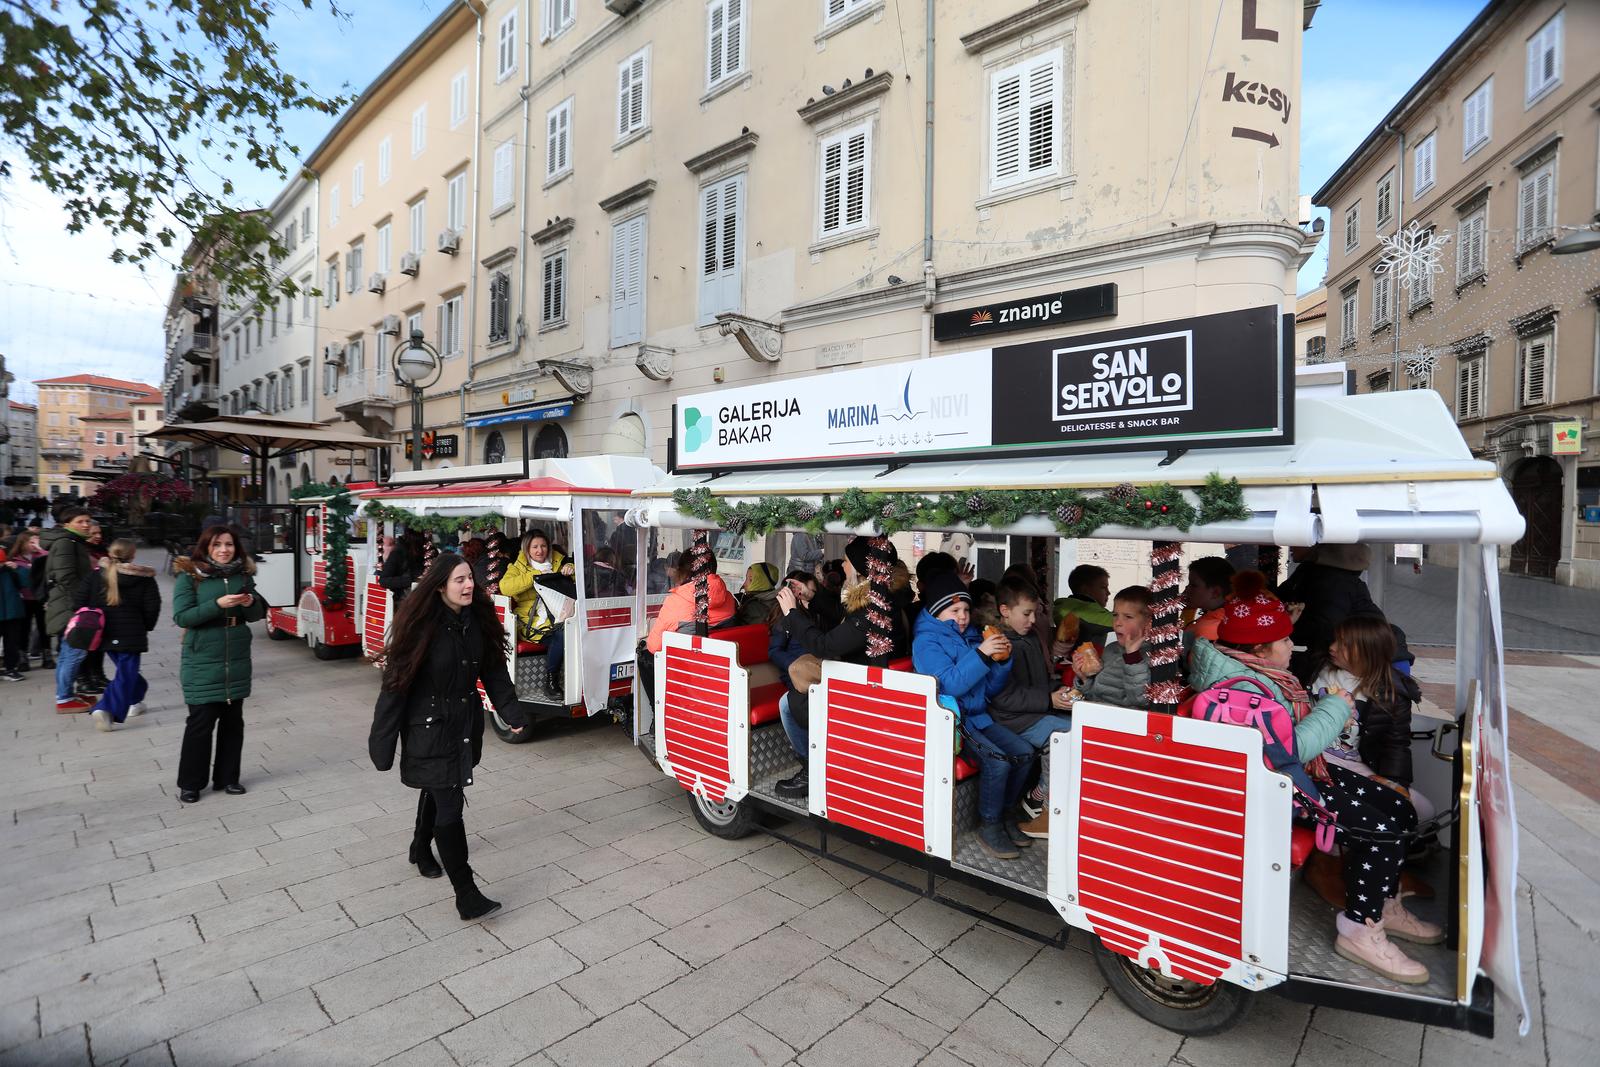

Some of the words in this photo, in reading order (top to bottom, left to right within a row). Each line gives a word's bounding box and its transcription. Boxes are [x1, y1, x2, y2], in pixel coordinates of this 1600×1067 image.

[1221, 71, 1292, 124] kosy
[998, 299, 1063, 324] znanje
[1092, 347, 1148, 380] SAN
[1061, 372, 1182, 411] SERVOLO
[718, 397, 801, 424] GALERIJA
[828, 403, 879, 430] MARINA
[929, 393, 969, 420] NOVI
[718, 424, 772, 447] BAKAR
[1060, 421, 1116, 433] DELICATESSE
[1118, 421, 1125, 429] &
[1127, 418, 1159, 428] SNACK
[1160, 417, 1180, 426] BAR
[436, 438, 453, 447] STREET
